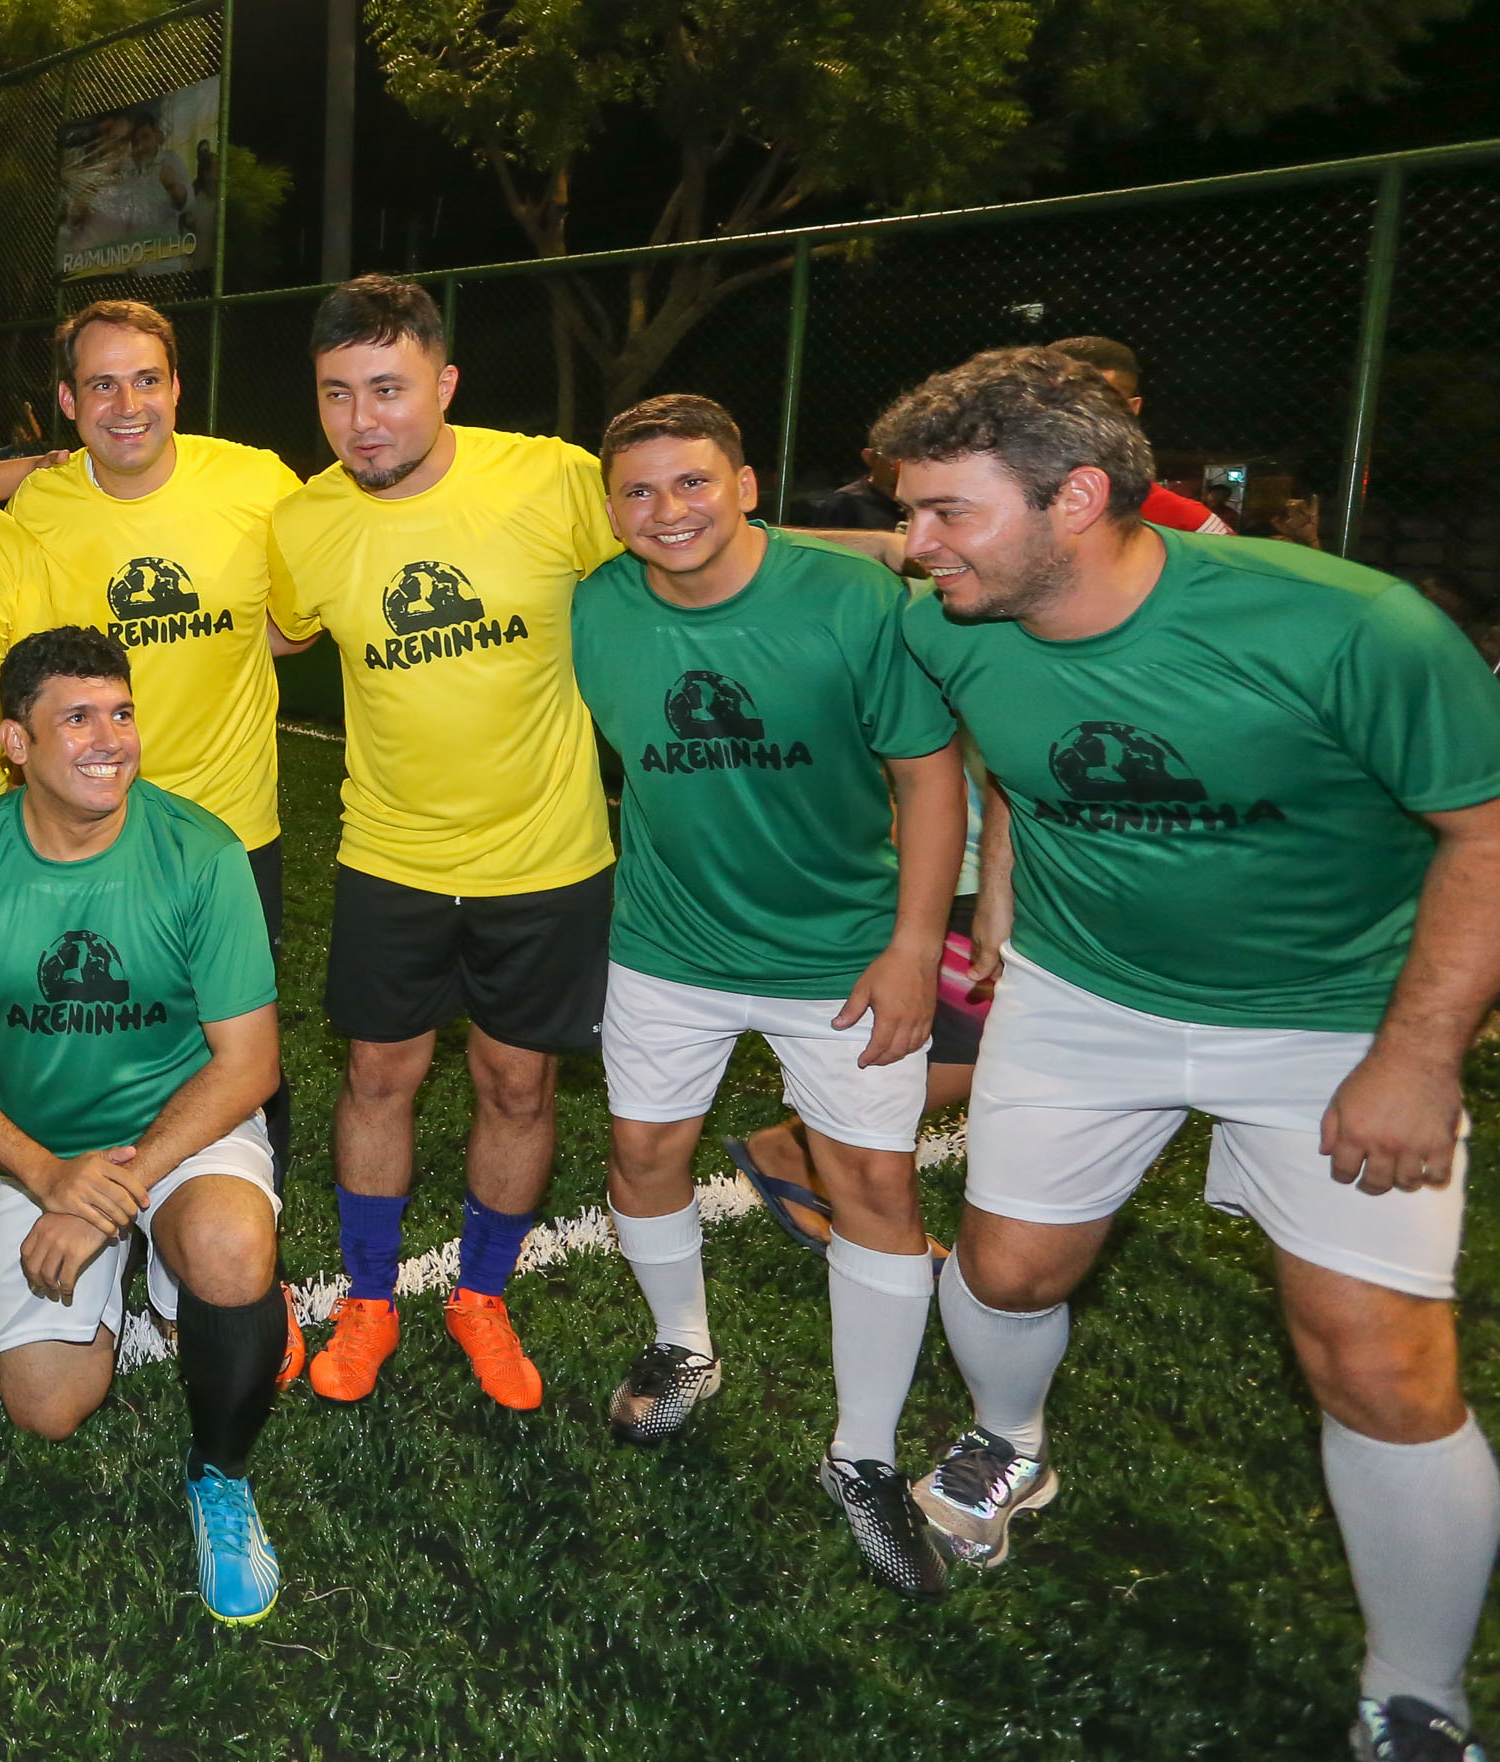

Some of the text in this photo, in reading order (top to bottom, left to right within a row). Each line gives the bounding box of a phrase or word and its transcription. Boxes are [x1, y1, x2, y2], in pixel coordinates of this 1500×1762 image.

[84, 609, 234, 651] RENINHA
[364, 615, 529, 671] ARENINHA
[640, 739, 813, 775] ARENINHA
[6, 1002, 168, 1036] ARENINHA
